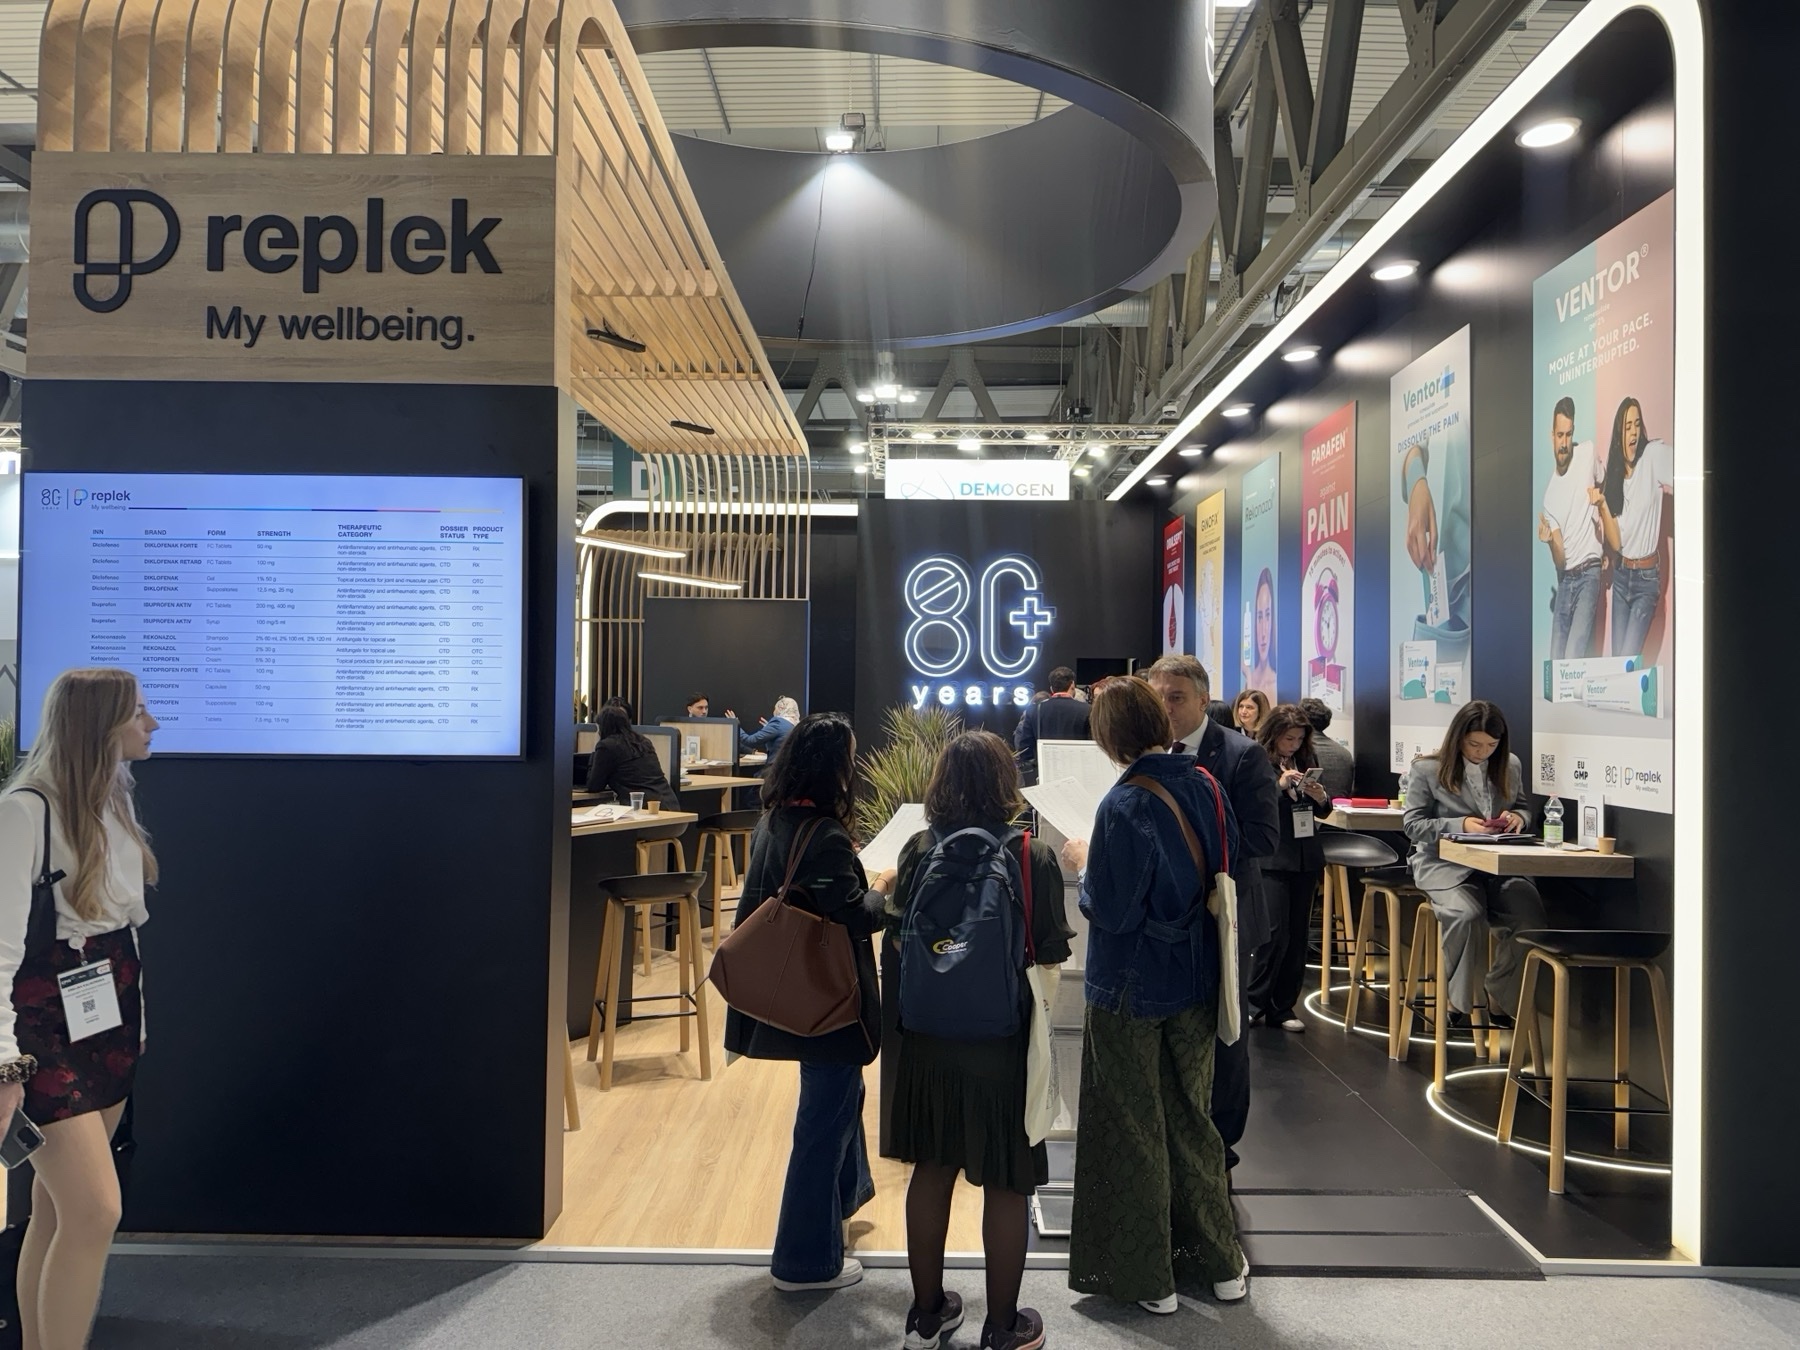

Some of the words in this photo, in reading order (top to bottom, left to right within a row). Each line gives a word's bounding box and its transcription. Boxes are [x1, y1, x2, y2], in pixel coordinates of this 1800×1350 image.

[207, 198, 502, 293] replek
[207, 306, 266, 348] My
[279, 307, 475, 350] wellbeing.
[1548, 352, 1575, 375] MOVE
[1578, 344, 1589, 360] AT
[1592, 329, 1618, 352] YOUR
[1622, 312, 1653, 338] PACE.
[1559, 338, 1640, 386] UNINTERRUPTED.
[1398, 428, 1426, 453] DISSOLVE
[1428, 421, 1441, 436] THE
[1443, 412, 1459, 430] PAIN
[92, 490, 131, 503] replek
[960, 482, 1054, 496] DEMOGEN
[1320, 481, 1336, 500] against
[1308, 492, 1348, 546] PAIN
[912, 684, 1030, 710] years
[1574, 770, 1588, 780] GMP
[1578, 761, 1584, 769] EU
[1636, 770, 1661, 784] replek
[942, 942, 968, 950] Cooper
